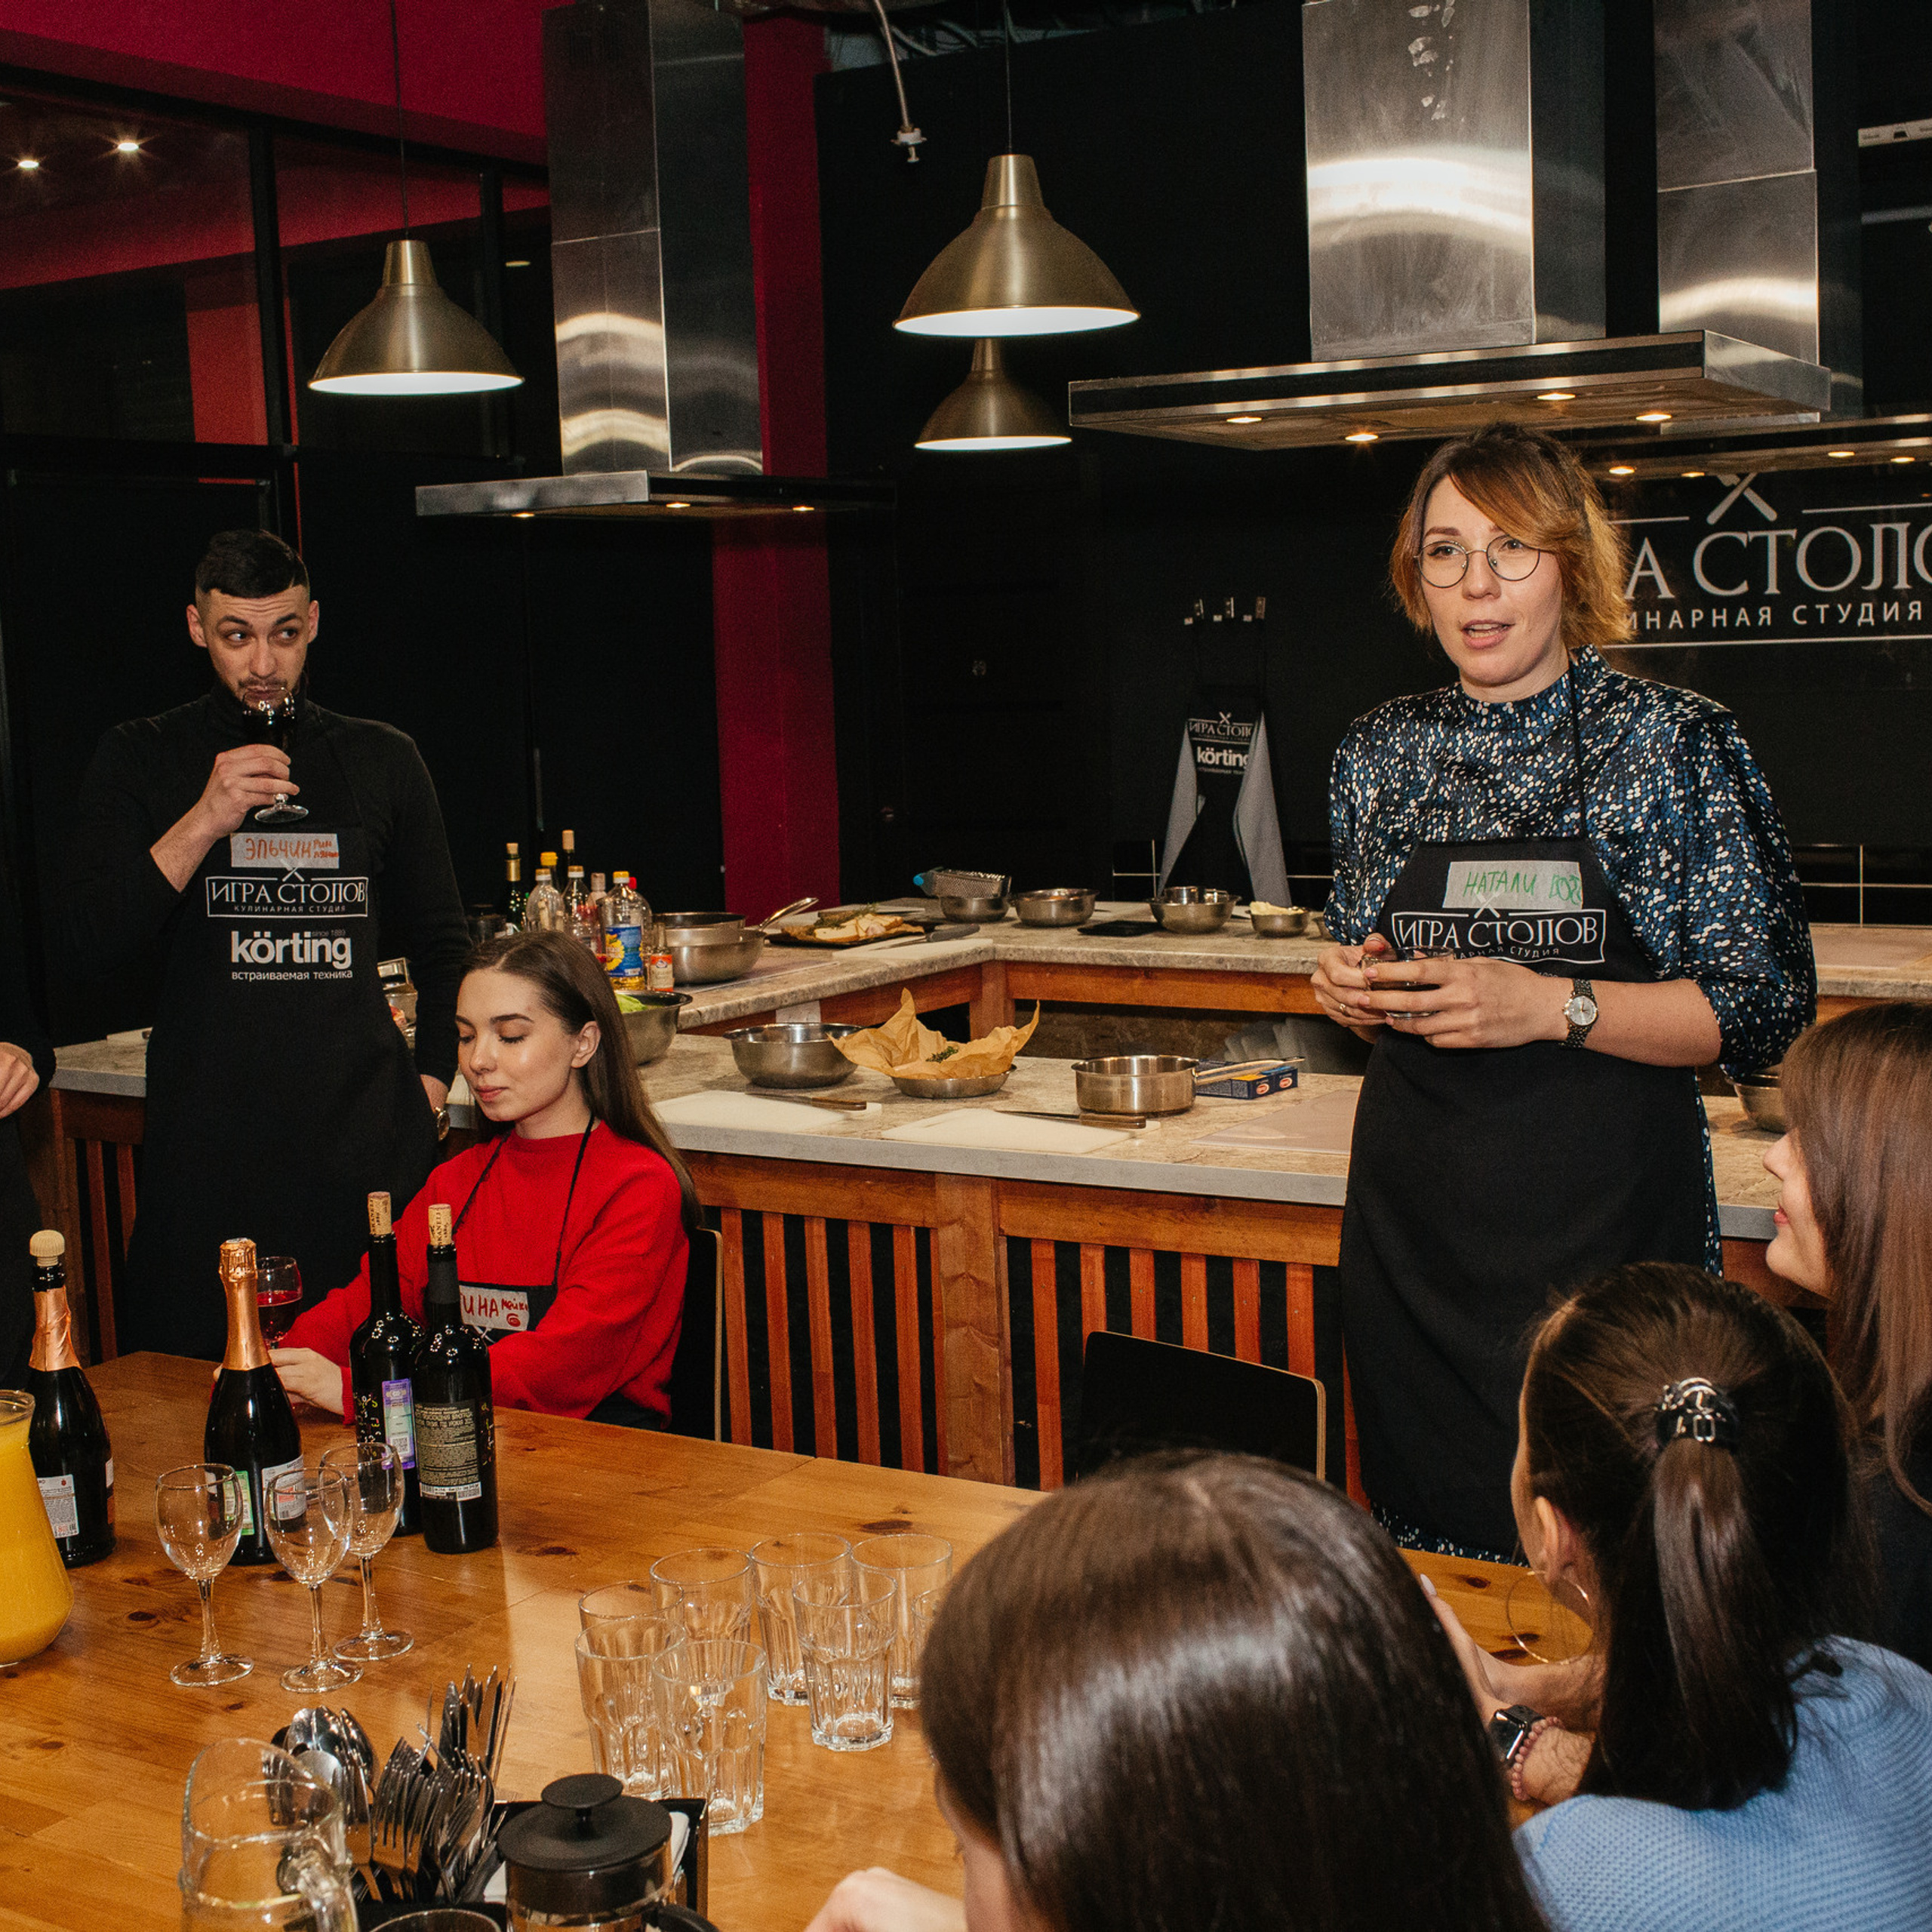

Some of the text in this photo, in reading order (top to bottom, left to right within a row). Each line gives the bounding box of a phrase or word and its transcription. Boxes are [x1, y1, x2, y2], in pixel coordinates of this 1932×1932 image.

[1792, 601, 1923, 627] СТУДИЯ
[211, 881, 366, 903] ИГРА СТОЛОВ
[1462, 869, 1537, 898] НАТАЛИ
[234, 905, 346, 913] КУЛИНАРНАЯ СТУДИЯ
[1398, 916, 1598, 949] ИГРА СТОЛОВ
[230, 930, 352, 970] körting
[1510, 945, 1561, 959] СТУДИЯ
[232, 969, 353, 981] встраиваемая техника
[460, 1292, 500, 1318] ИНА
